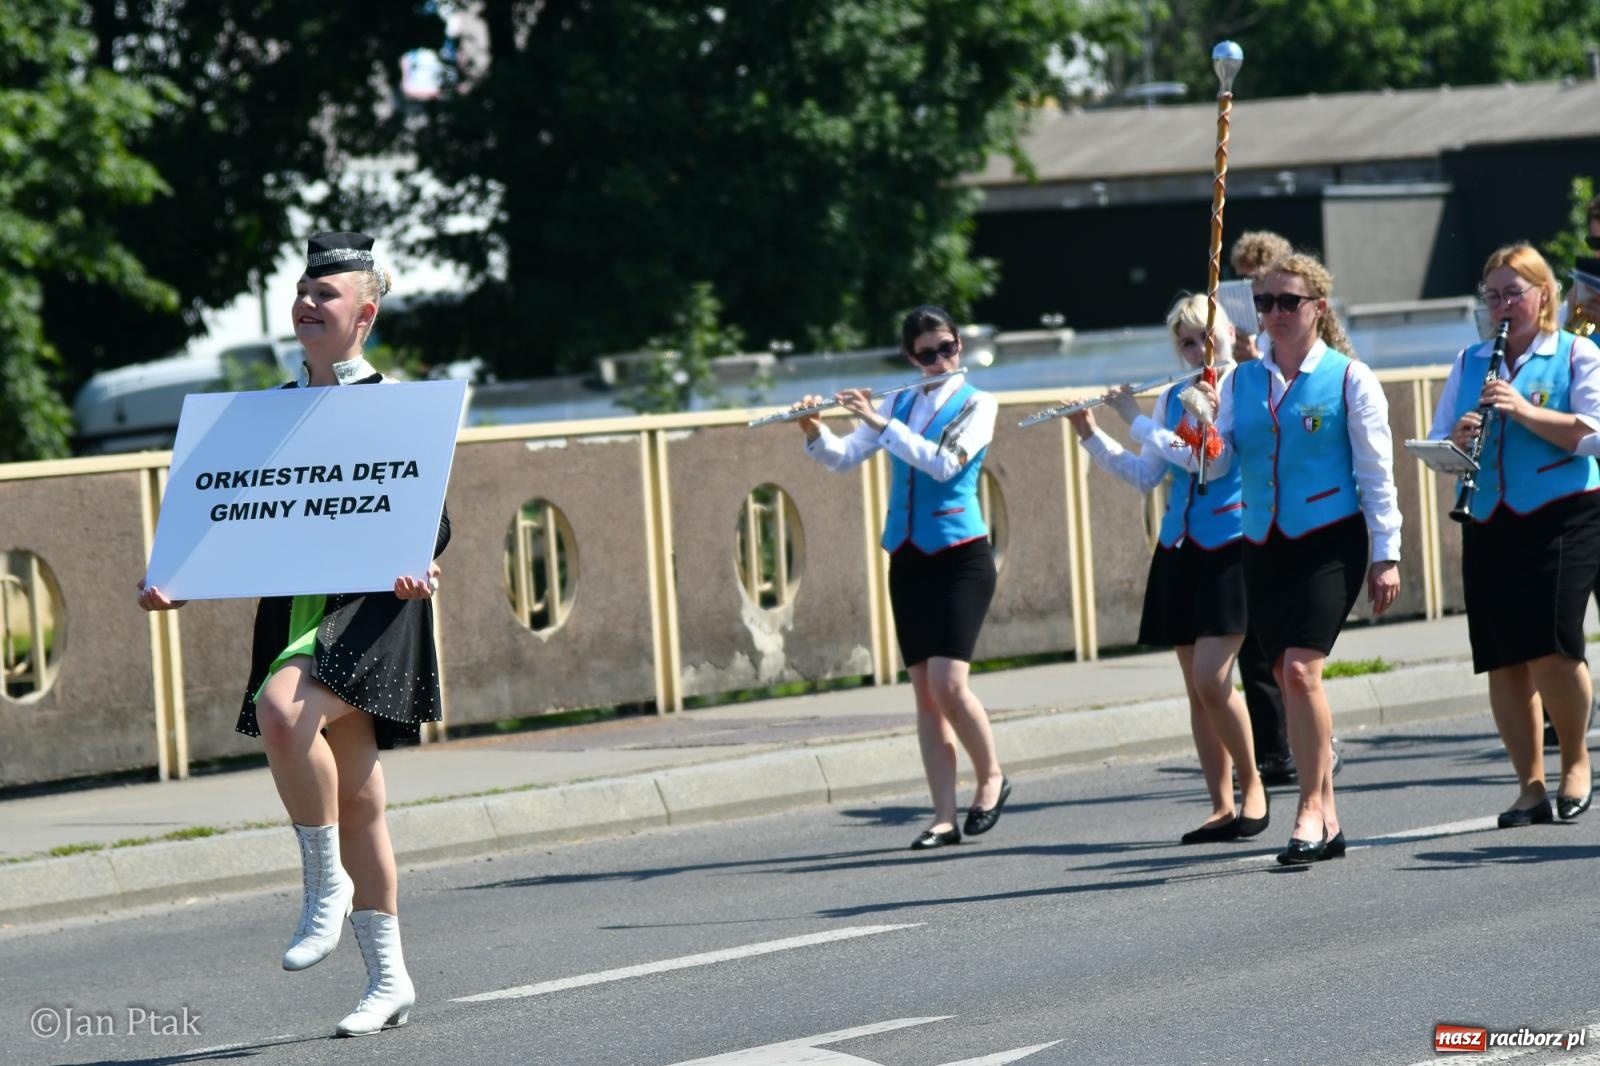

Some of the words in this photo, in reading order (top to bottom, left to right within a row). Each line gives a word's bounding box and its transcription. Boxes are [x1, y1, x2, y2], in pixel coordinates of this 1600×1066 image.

[195, 464, 344, 491] ORKIESTRA
[352, 460, 419, 485] DĘTA
[209, 500, 297, 522] GMINY
[303, 494, 391, 520] NĘDZA
